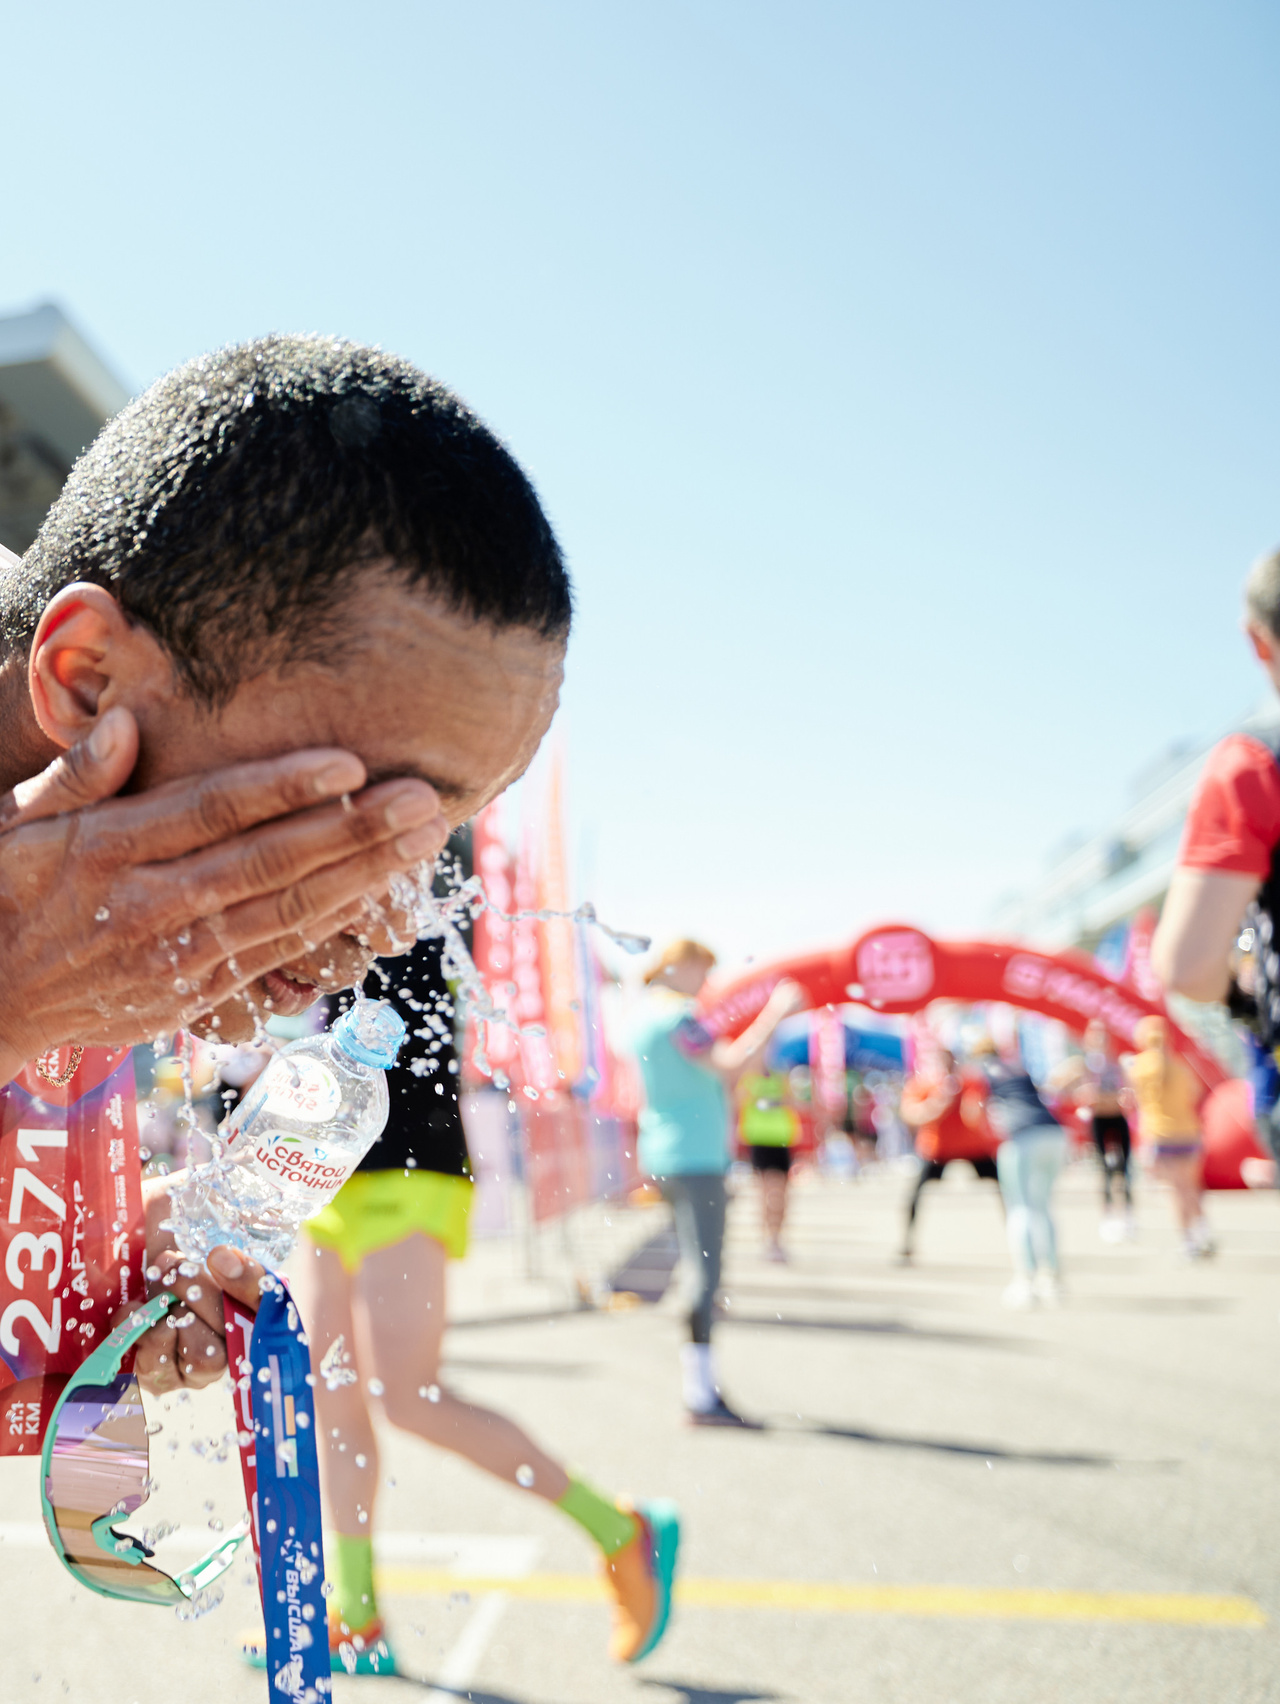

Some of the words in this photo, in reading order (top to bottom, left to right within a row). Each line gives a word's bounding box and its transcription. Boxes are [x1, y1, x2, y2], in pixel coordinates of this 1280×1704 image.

[274, 1145, 346, 1178] СВЯТОЙ
[0, 1128, 68, 1355] 2371
[9, 1402, 24, 1435] 21.1
[286, 1569, 304, 1671] ВЫСШАЯ
